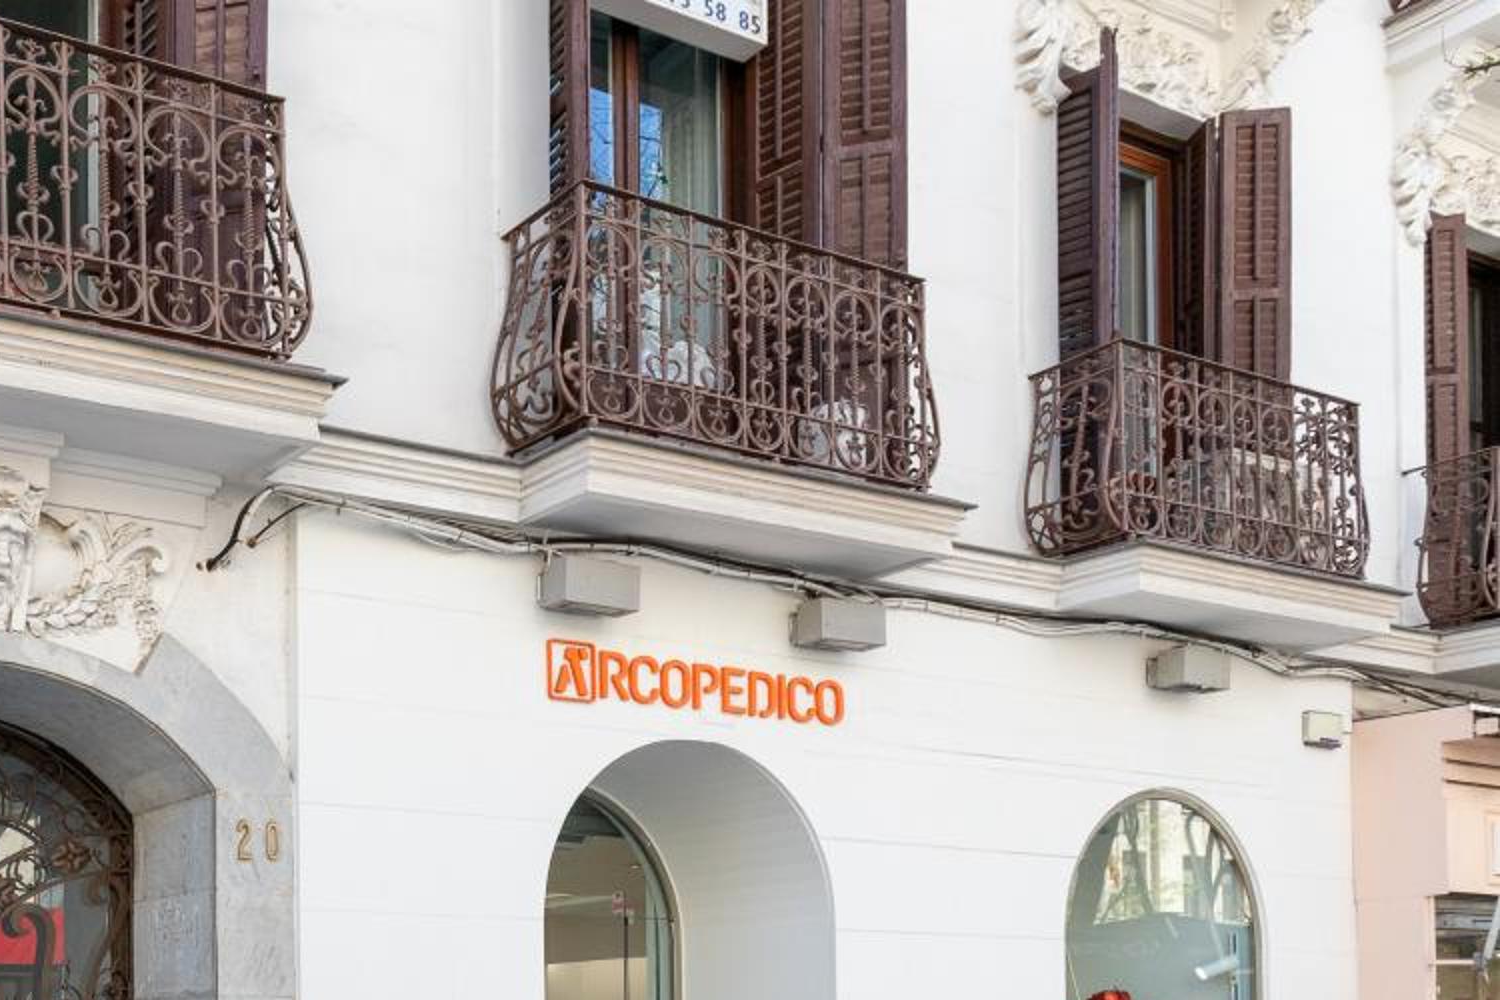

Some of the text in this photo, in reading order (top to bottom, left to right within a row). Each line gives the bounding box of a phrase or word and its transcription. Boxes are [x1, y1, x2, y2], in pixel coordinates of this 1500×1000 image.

[705, 0, 761, 34] 58 85
[546, 638, 845, 727] ARCOPEDICO
[235, 818, 280, 864] 20
